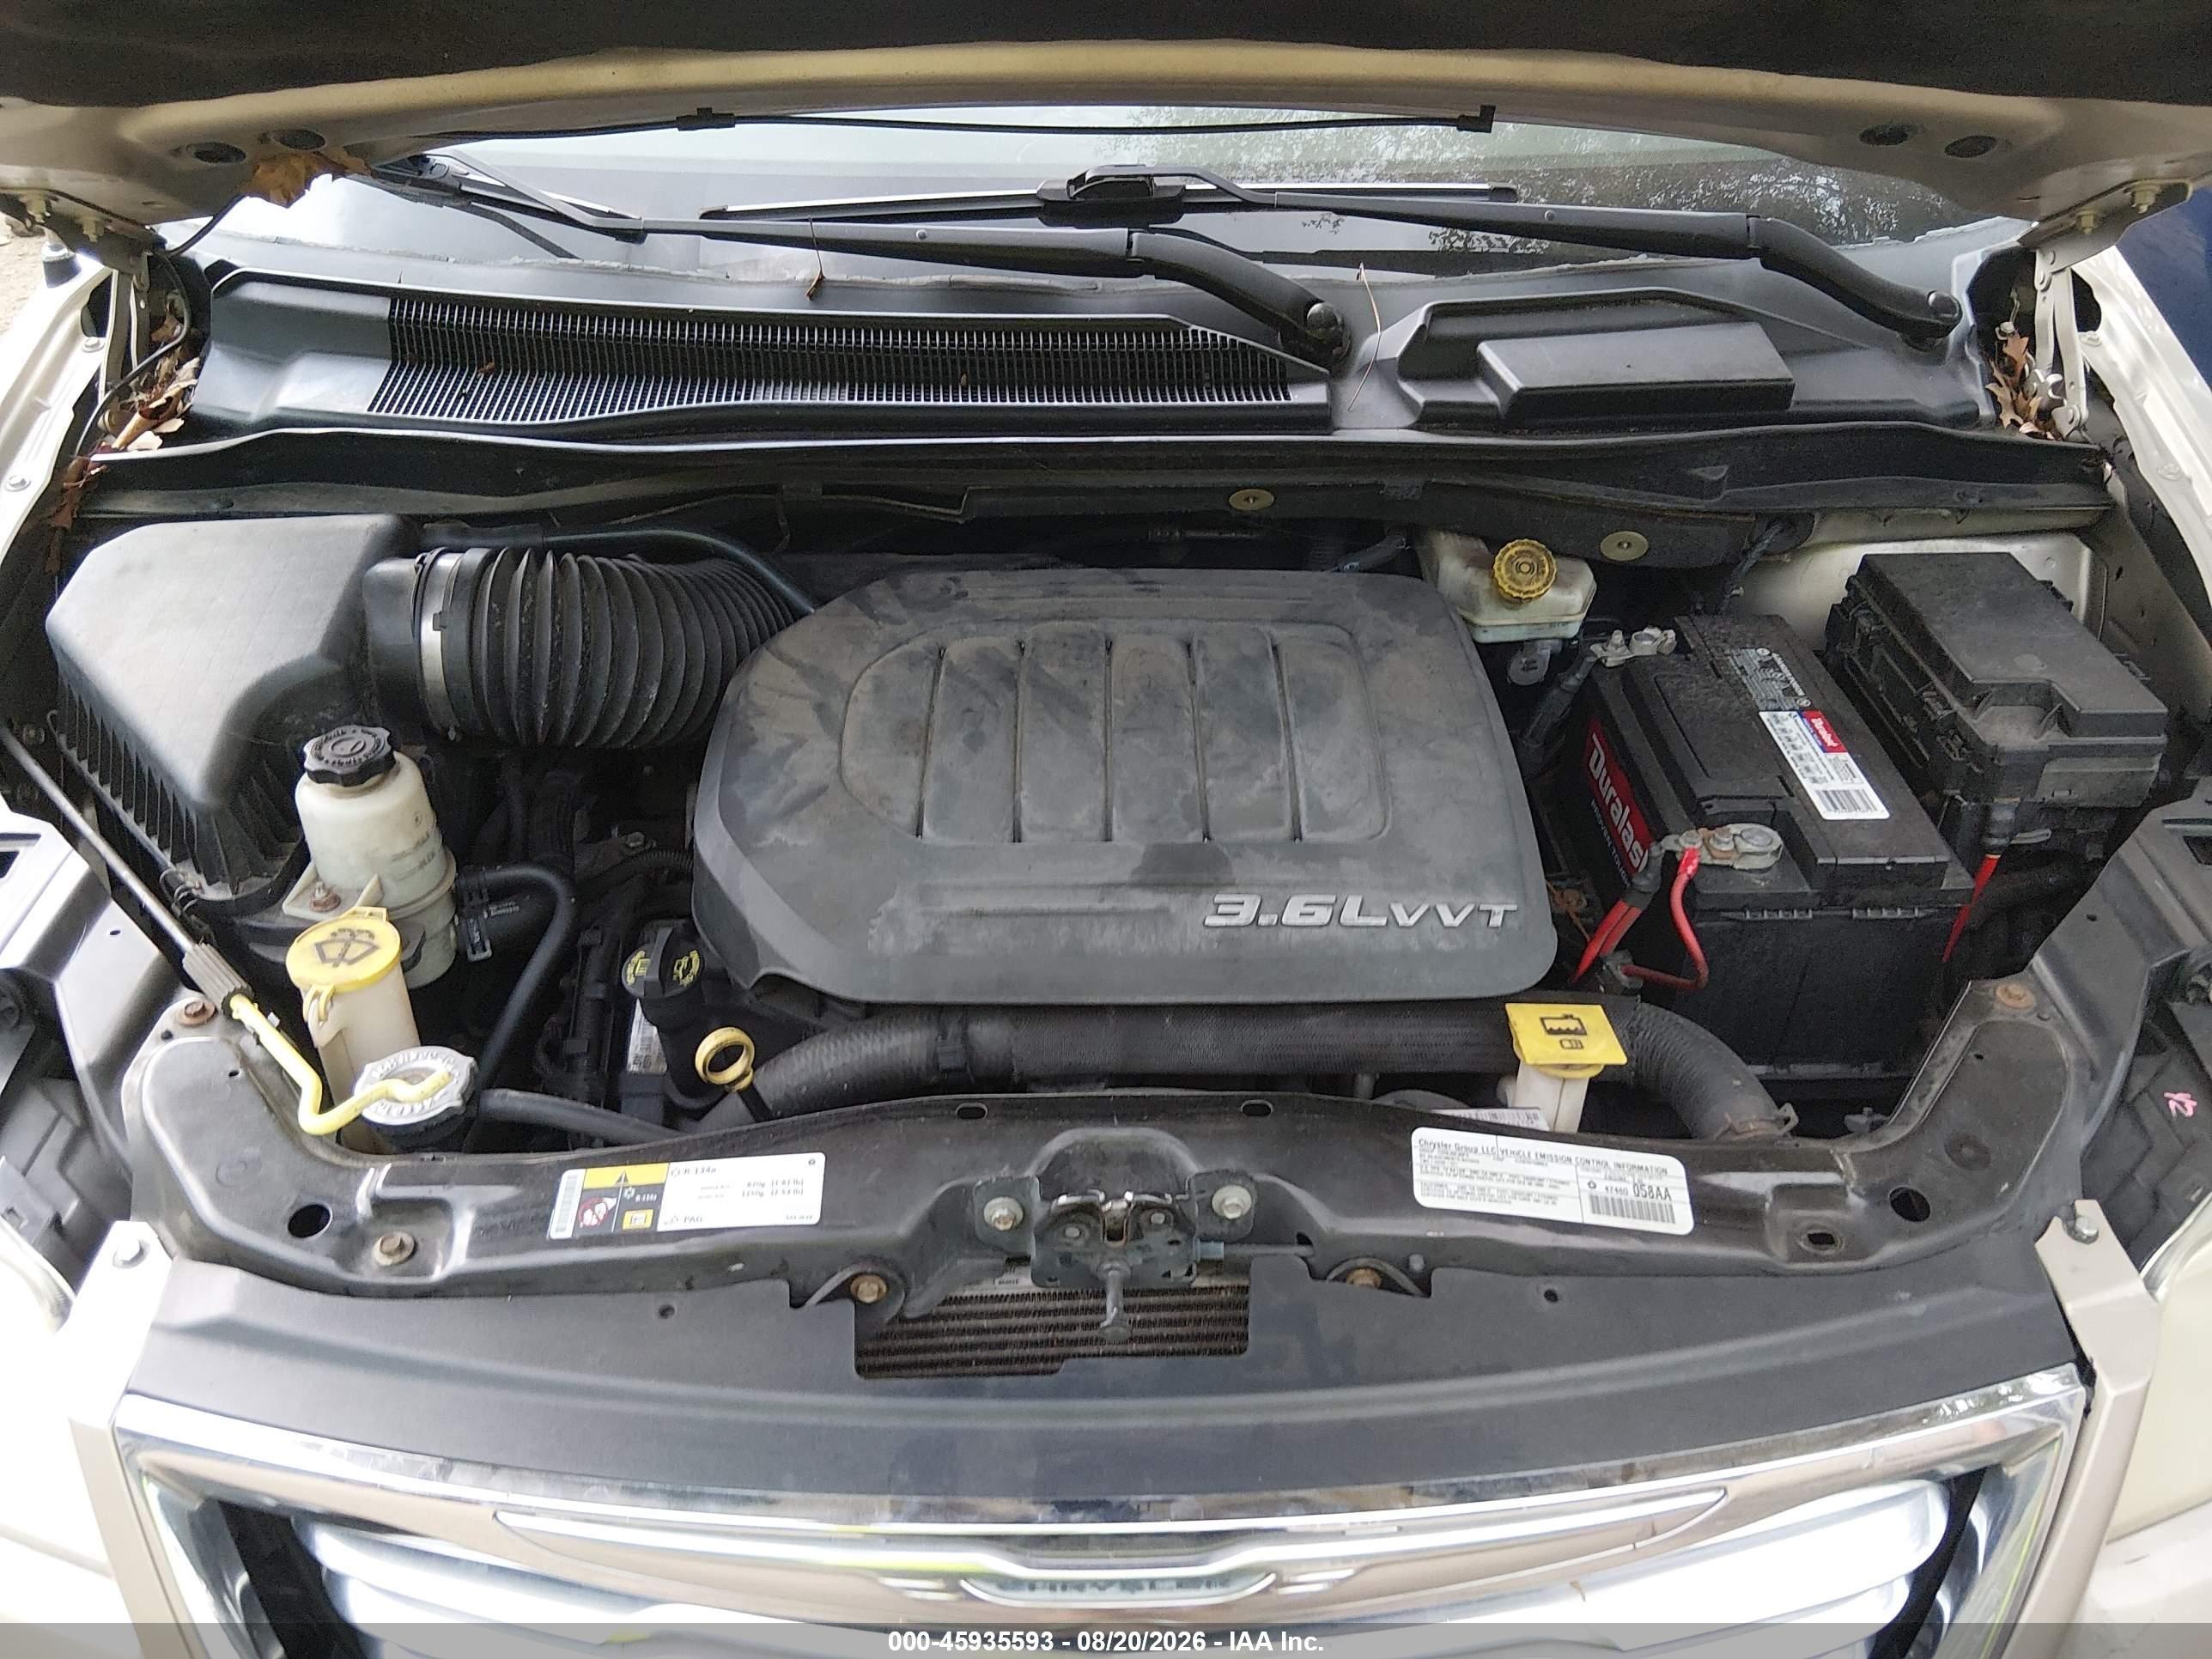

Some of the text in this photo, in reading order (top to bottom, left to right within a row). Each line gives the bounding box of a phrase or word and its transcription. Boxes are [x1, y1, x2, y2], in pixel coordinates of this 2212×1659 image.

[1419, 1139, 1451, 1150] Chrysler
[1455, 1142, 1479, 1155] Group
[1481, 1146, 1496, 1155] LLC
[1500, 1147, 1531, 1158] VEHICLE
[1534, 1152, 1572, 1164] EMISSION
[1575, 1157, 1609, 1168] CONTROL
[1613, 1162, 1668, 1175] INFORMATION
